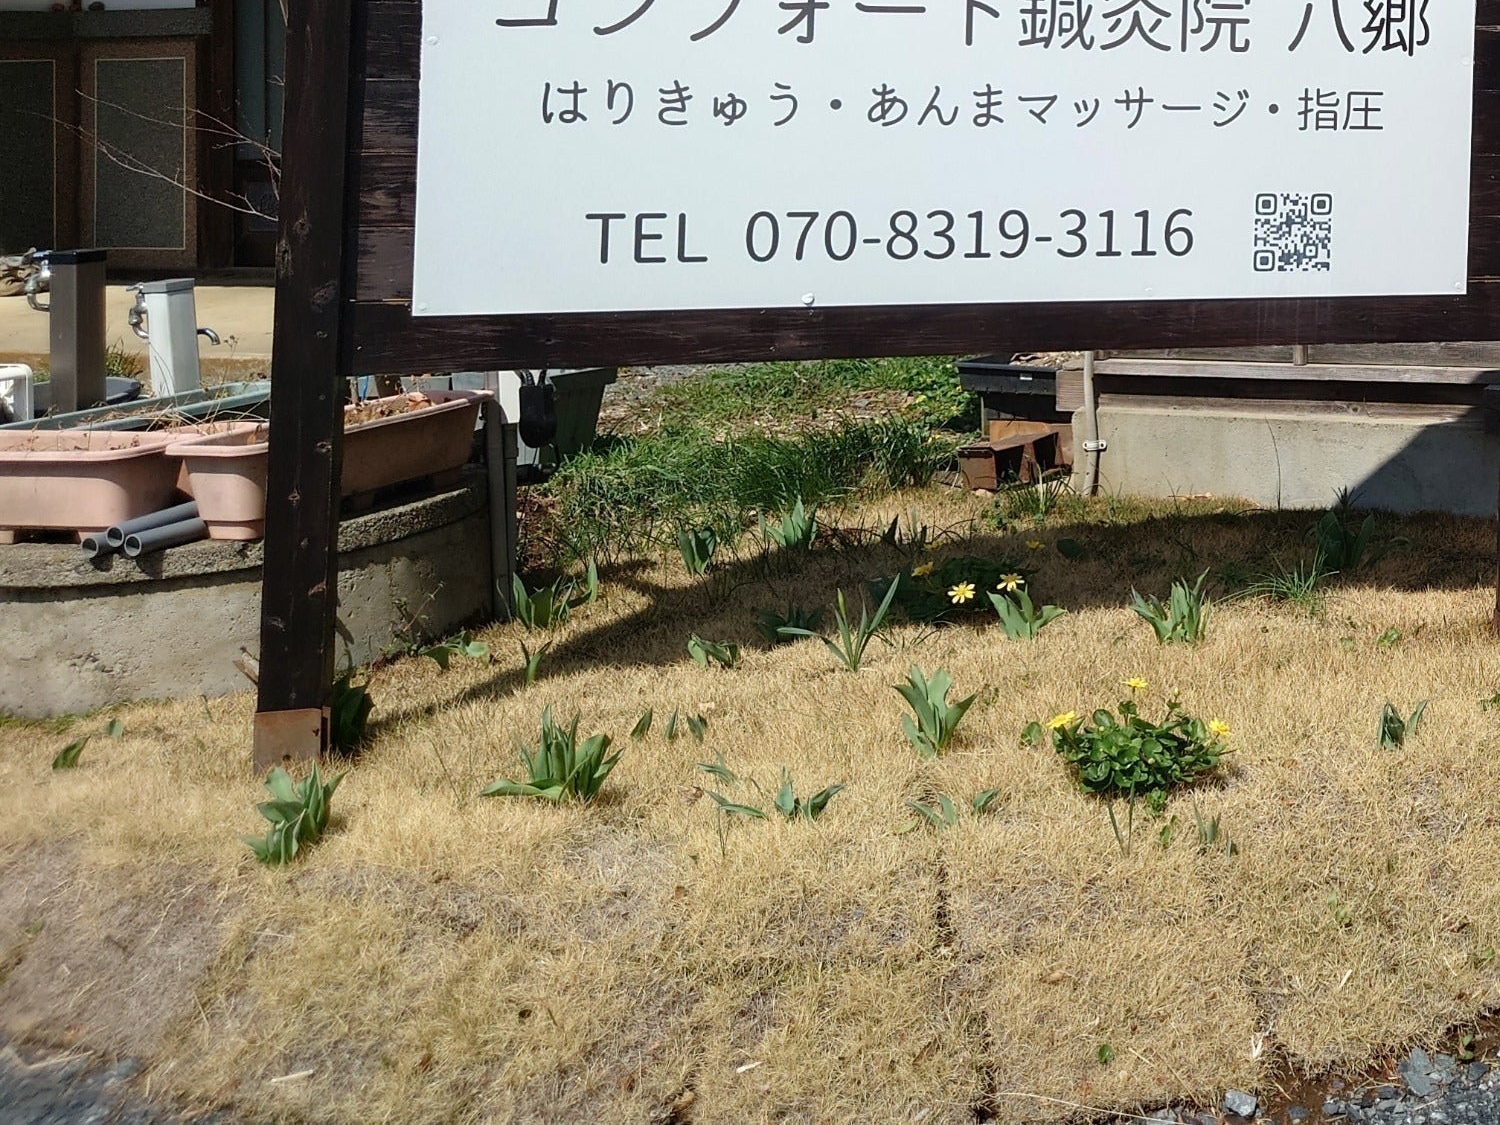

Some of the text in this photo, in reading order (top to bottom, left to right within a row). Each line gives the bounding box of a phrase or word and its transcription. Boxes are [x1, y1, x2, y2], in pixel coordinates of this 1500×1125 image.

[541, 79, 1384, 132] はりきゅう・あんまマッサージ・指圧
[585, 207, 1195, 264] TEL 070-8319-3116
